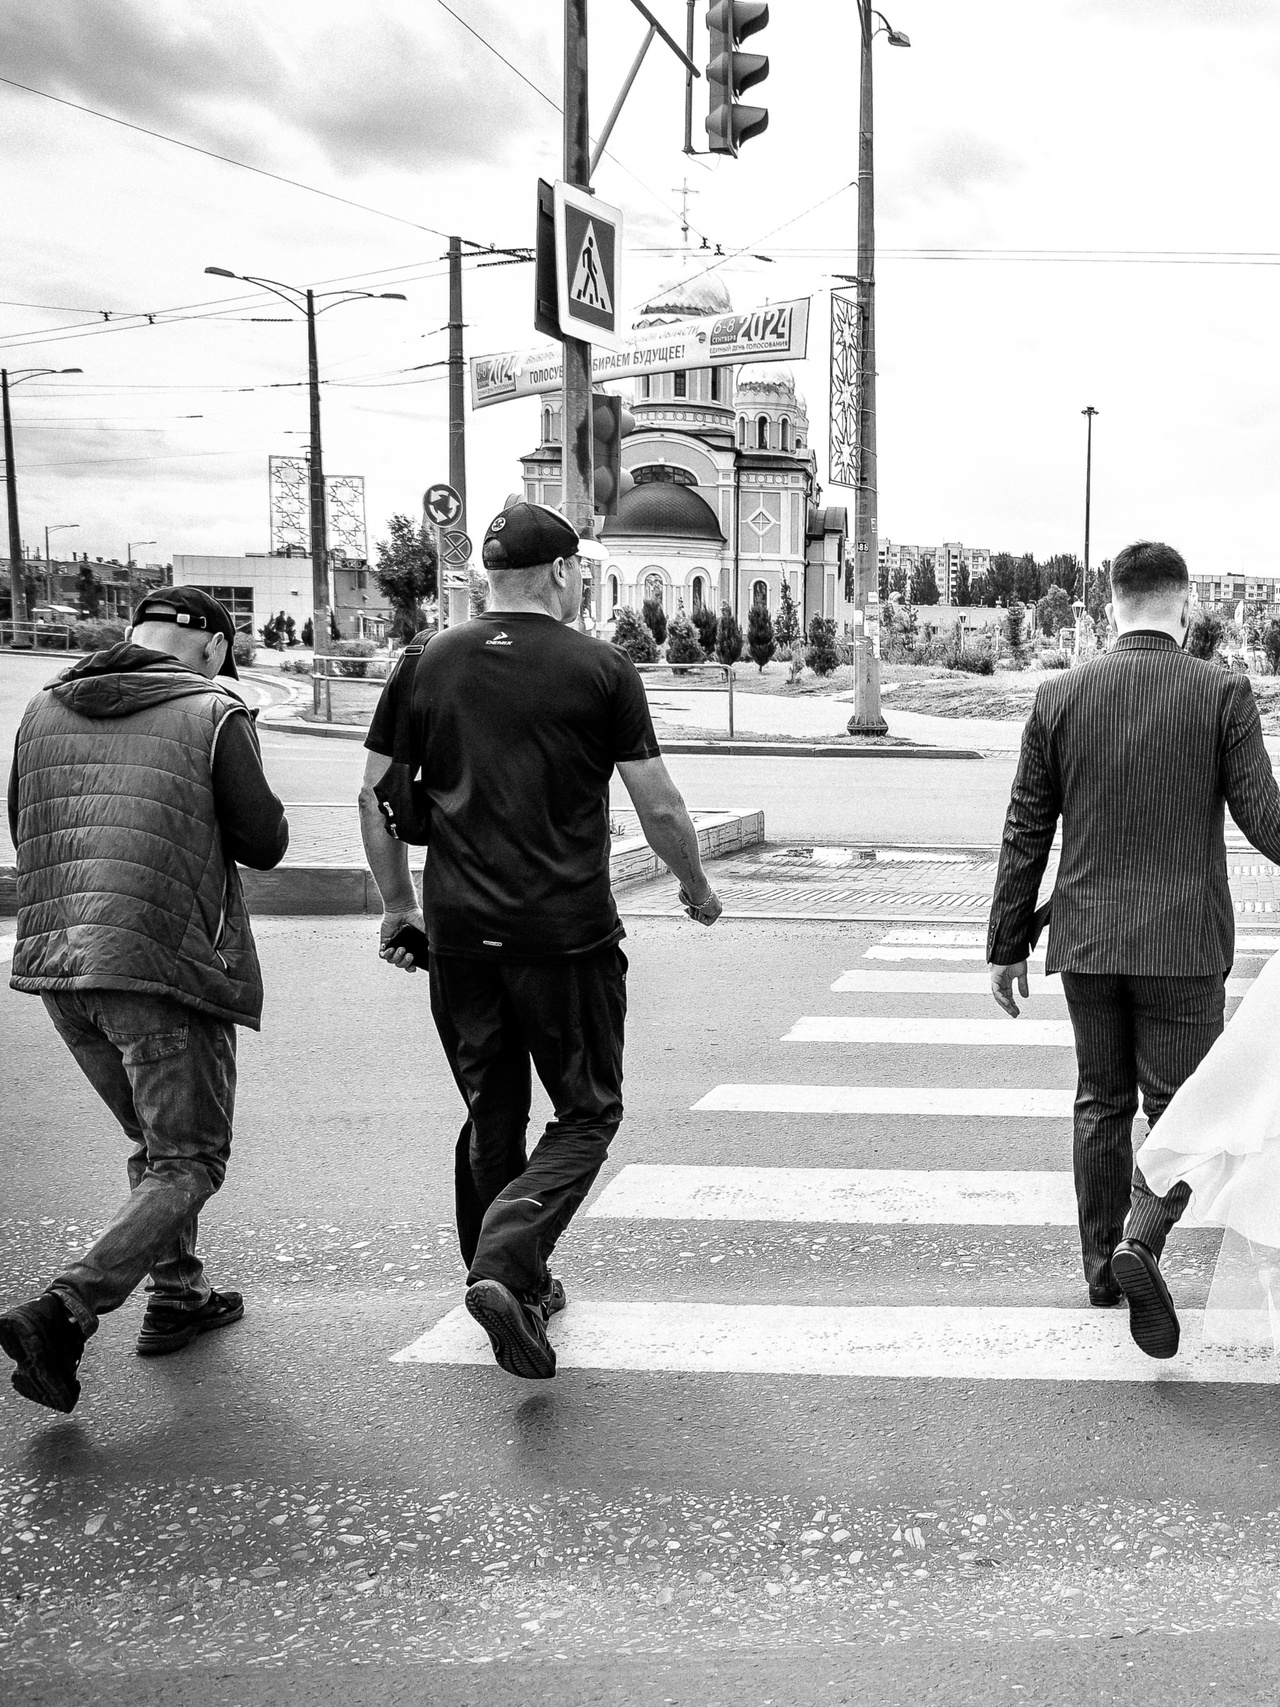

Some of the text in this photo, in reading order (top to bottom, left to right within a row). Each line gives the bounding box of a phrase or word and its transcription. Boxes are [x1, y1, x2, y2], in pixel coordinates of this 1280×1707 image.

[714, 308, 789, 342] 6-8 2024
[592, 353, 631, 371] БИРАЕМ
[633, 344, 686, 366] БУДУЩЕЕ!
[746, 340, 789, 350] ГОЛОСОВАНИЯ
